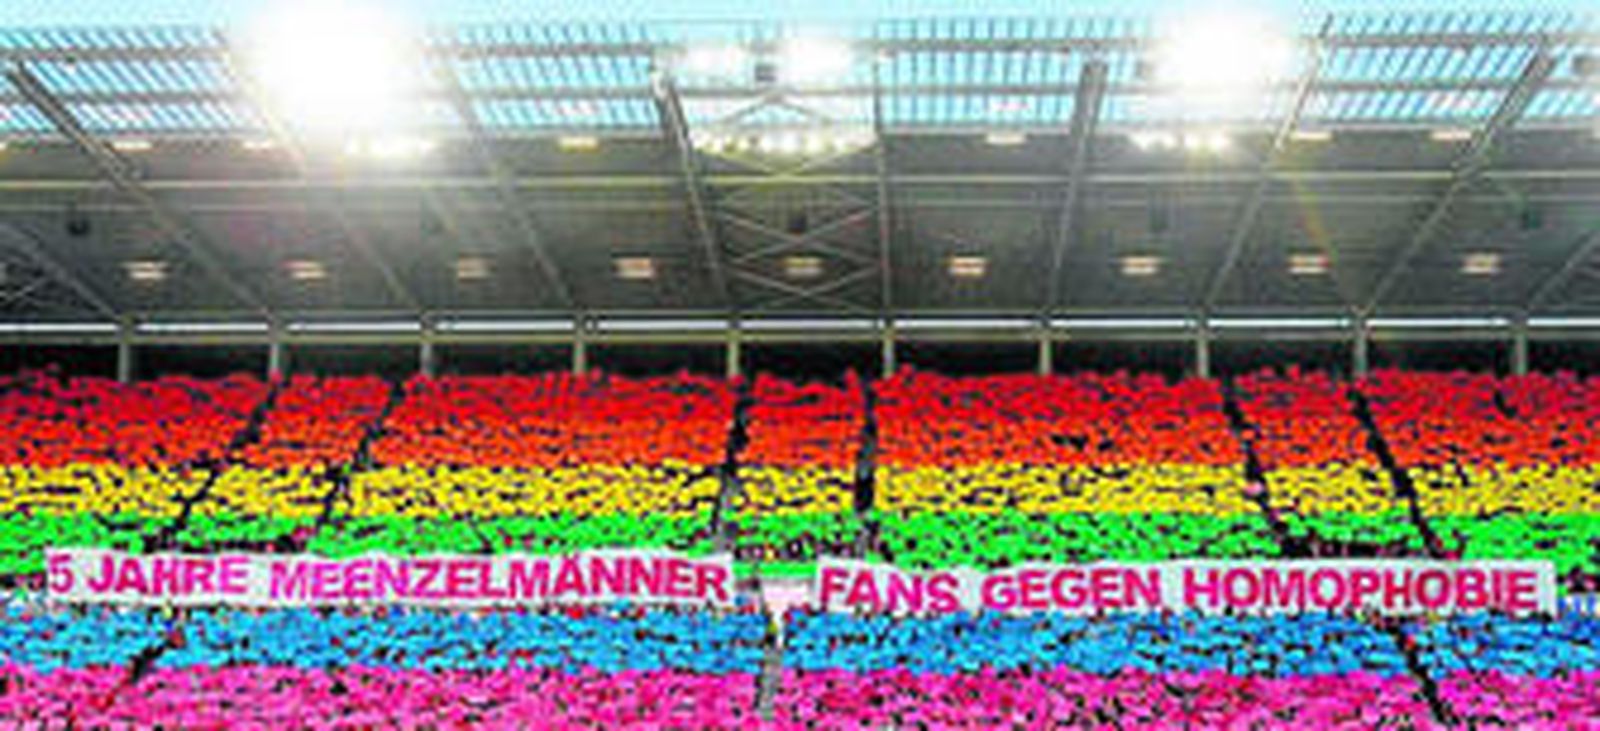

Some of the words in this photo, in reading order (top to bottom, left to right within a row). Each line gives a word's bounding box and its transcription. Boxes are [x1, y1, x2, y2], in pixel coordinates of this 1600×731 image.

[49, 554, 74, 593] 5
[86, 554, 249, 597] JAHRE
[269, 553, 729, 601] MEENZELMÄNNER
[819, 567, 960, 612] FANS
[981, 568, 1162, 609] GEGEN
[1182, 567, 1538, 609] HOMOPHOBIE
